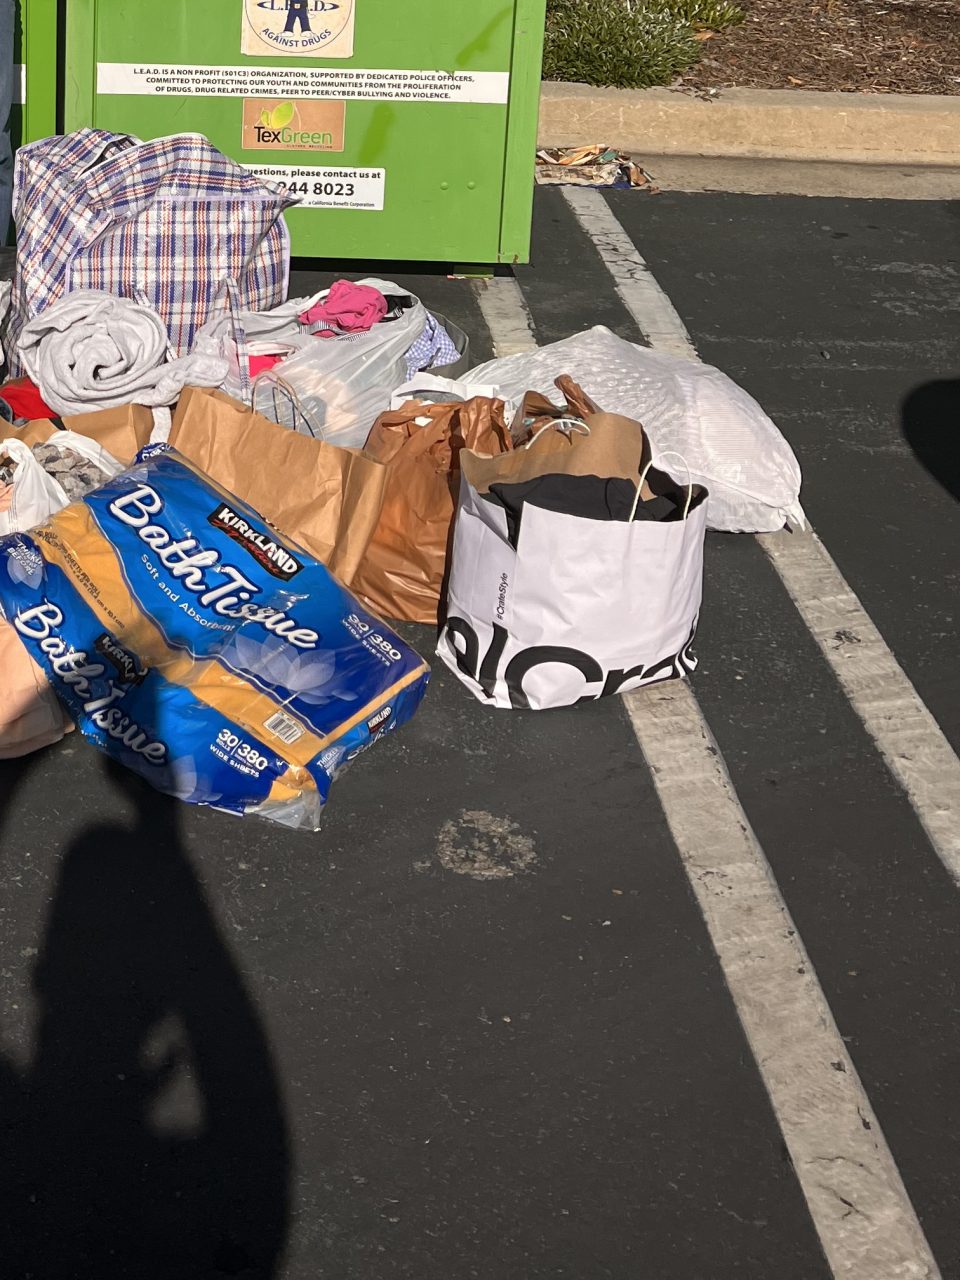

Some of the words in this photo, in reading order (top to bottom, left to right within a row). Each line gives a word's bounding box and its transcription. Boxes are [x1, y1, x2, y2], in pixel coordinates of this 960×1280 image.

[262, 27, 300, 48] AGAINST
[301, 28, 332, 48] DRUGS
[254, 126, 332, 144] TexGreen
[246, 168, 288, 176] uestions,
[291, 169, 321, 178] please
[323, 170, 357, 178] contact
[313, 183, 354, 196] 8023
[218, 507, 298, 574] KIRKLAND
[110, 483, 219, 591] Bath
[201, 566, 319, 649] Tissue
[141, 554, 160, 580] Soft
[158, 581, 178, 602] and
[179, 602, 236, 632] Absorbent
[14, 602, 104, 699] Bath
[349, 614, 369, 631] 30
[370, 634, 401, 660] 380
[210, 744, 229, 761] WIDE
[230, 759, 260, 778] SHEETS
[218, 728, 238, 747] 30
[238, 744, 268, 770] 380
